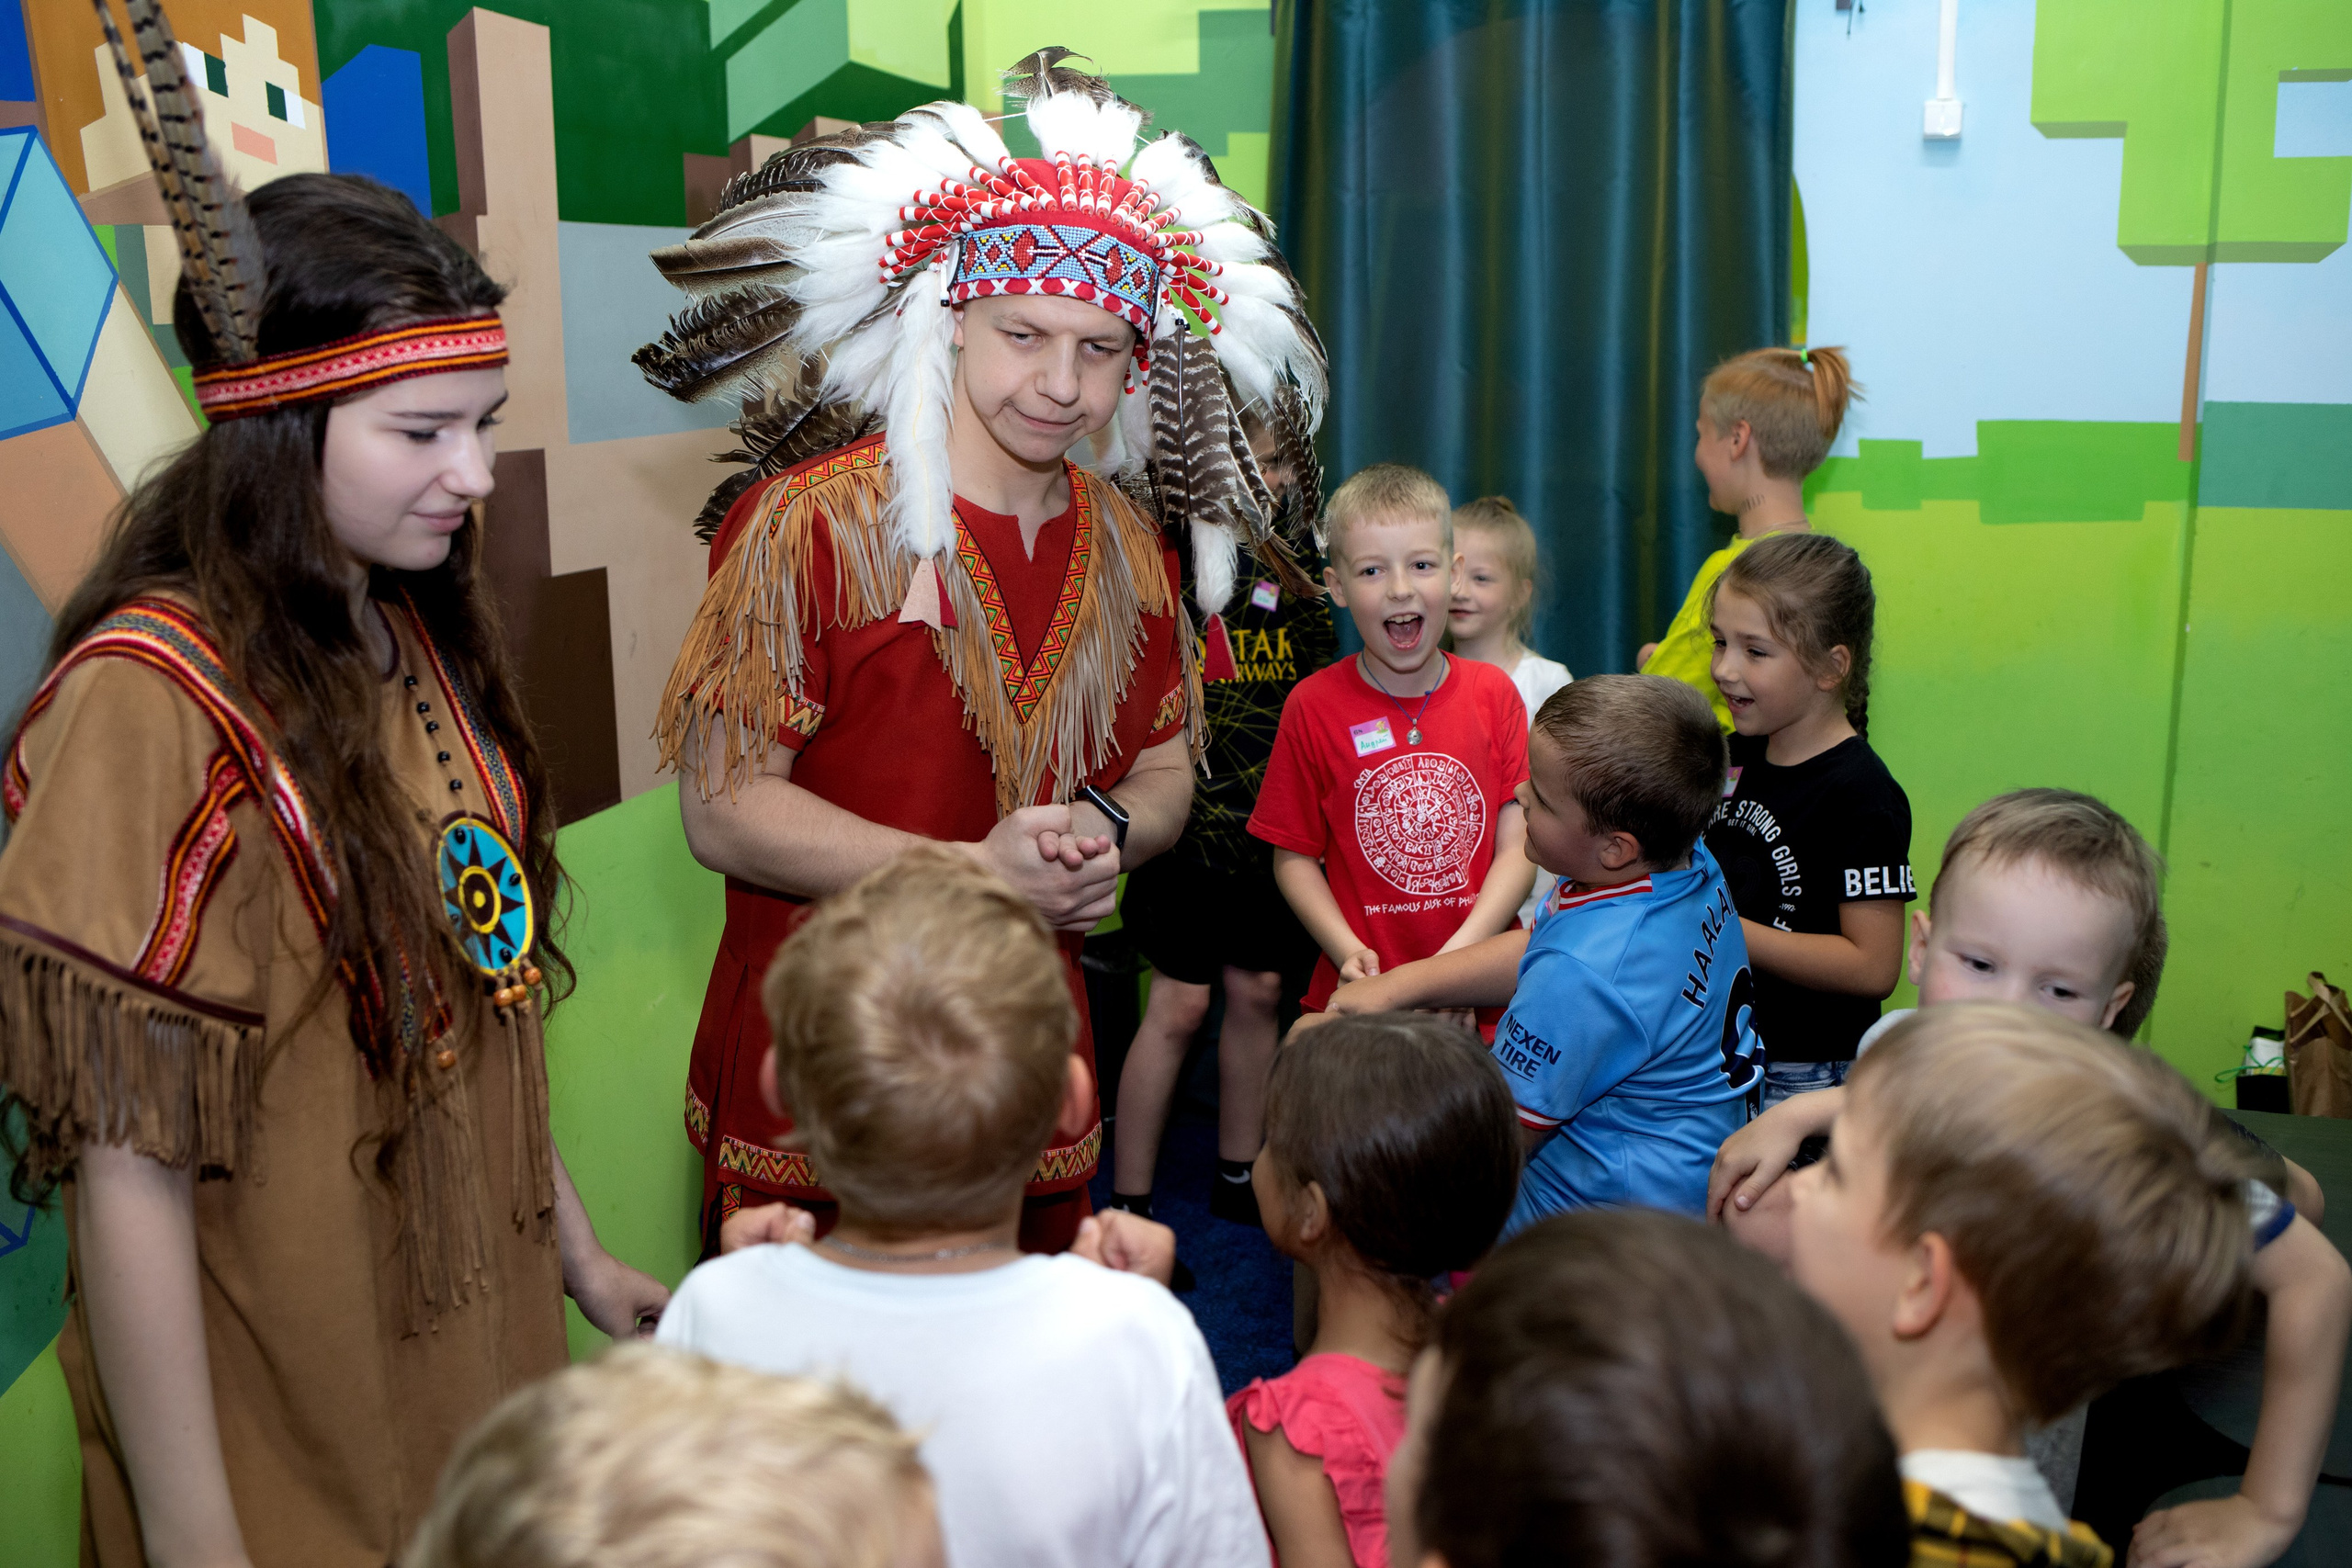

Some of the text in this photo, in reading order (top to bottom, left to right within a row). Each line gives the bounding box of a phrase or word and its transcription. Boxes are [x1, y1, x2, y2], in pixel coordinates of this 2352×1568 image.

[1210, 660, 1296, 683] RWAYS
[1735, 799, 1781, 842] STRONG
[1771, 845, 1802, 896] GIRLS
[1364, 905, 1381, 916] THE
[1382, 901, 1420, 914] FAMOUS
[1443, 897, 1456, 908] OF
[1499, 1038, 1542, 1078] TIRE
[1506, 1013, 1562, 1066] NEXEN
